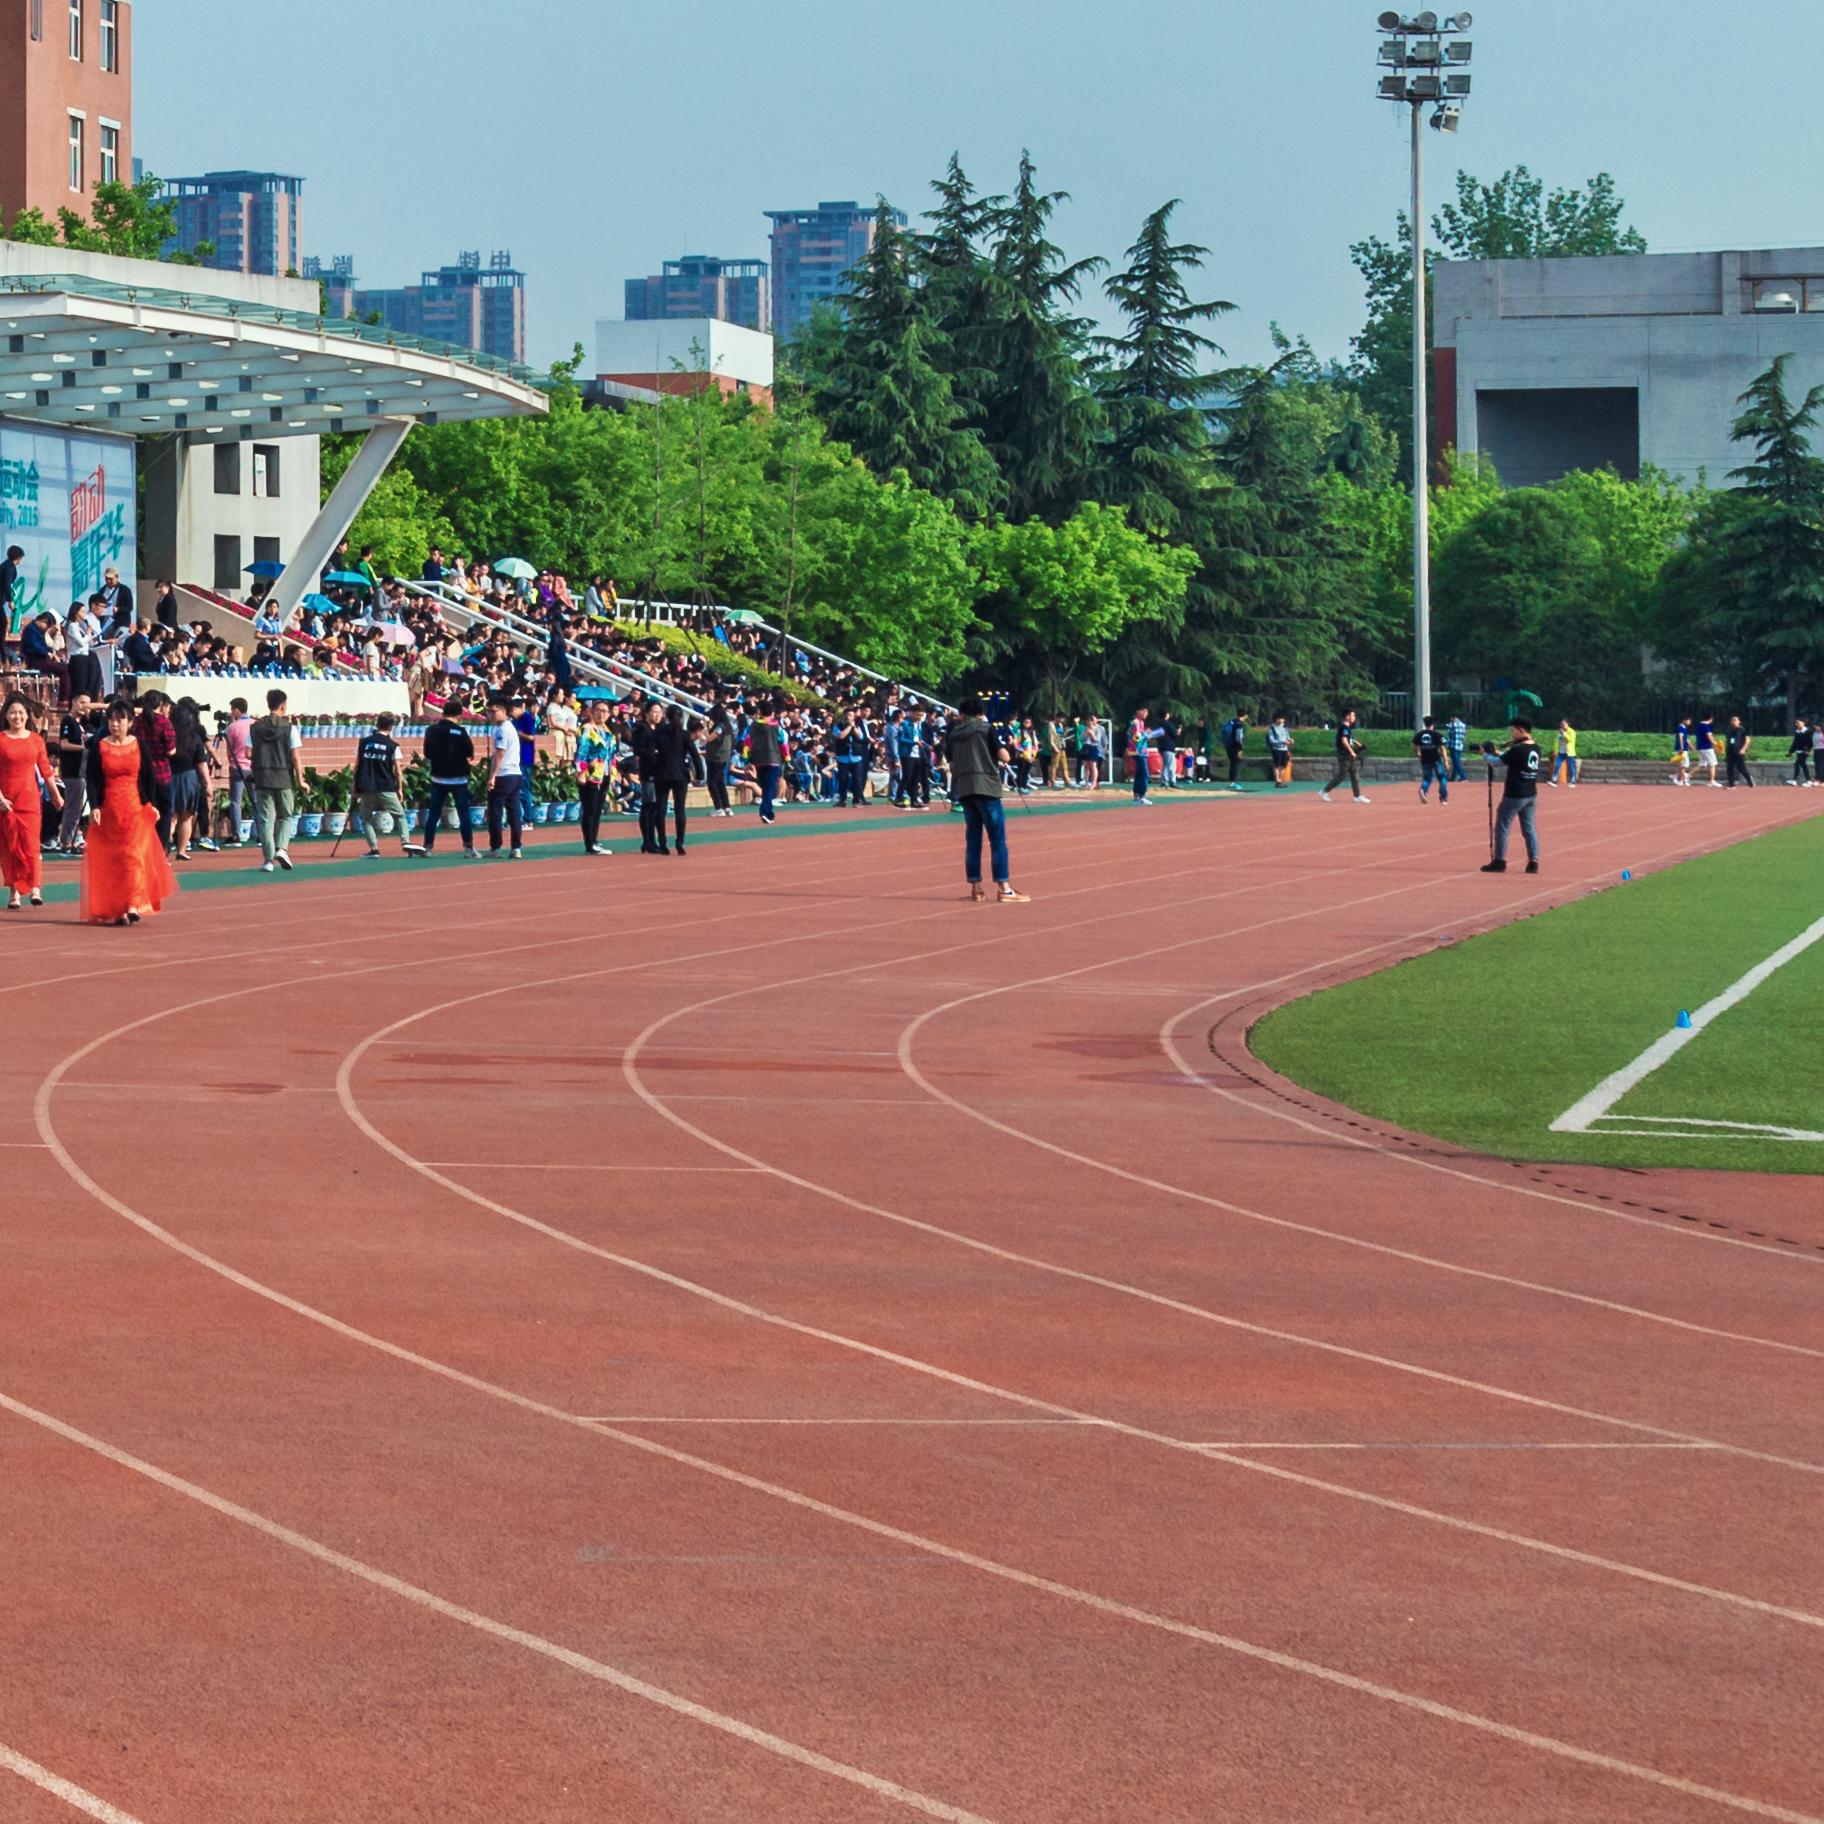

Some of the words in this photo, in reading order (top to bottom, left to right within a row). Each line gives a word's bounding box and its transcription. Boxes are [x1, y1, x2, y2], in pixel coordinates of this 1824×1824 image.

[18, 504, 38, 526] 2016
[70, 501, 125, 604] 嘉年华
